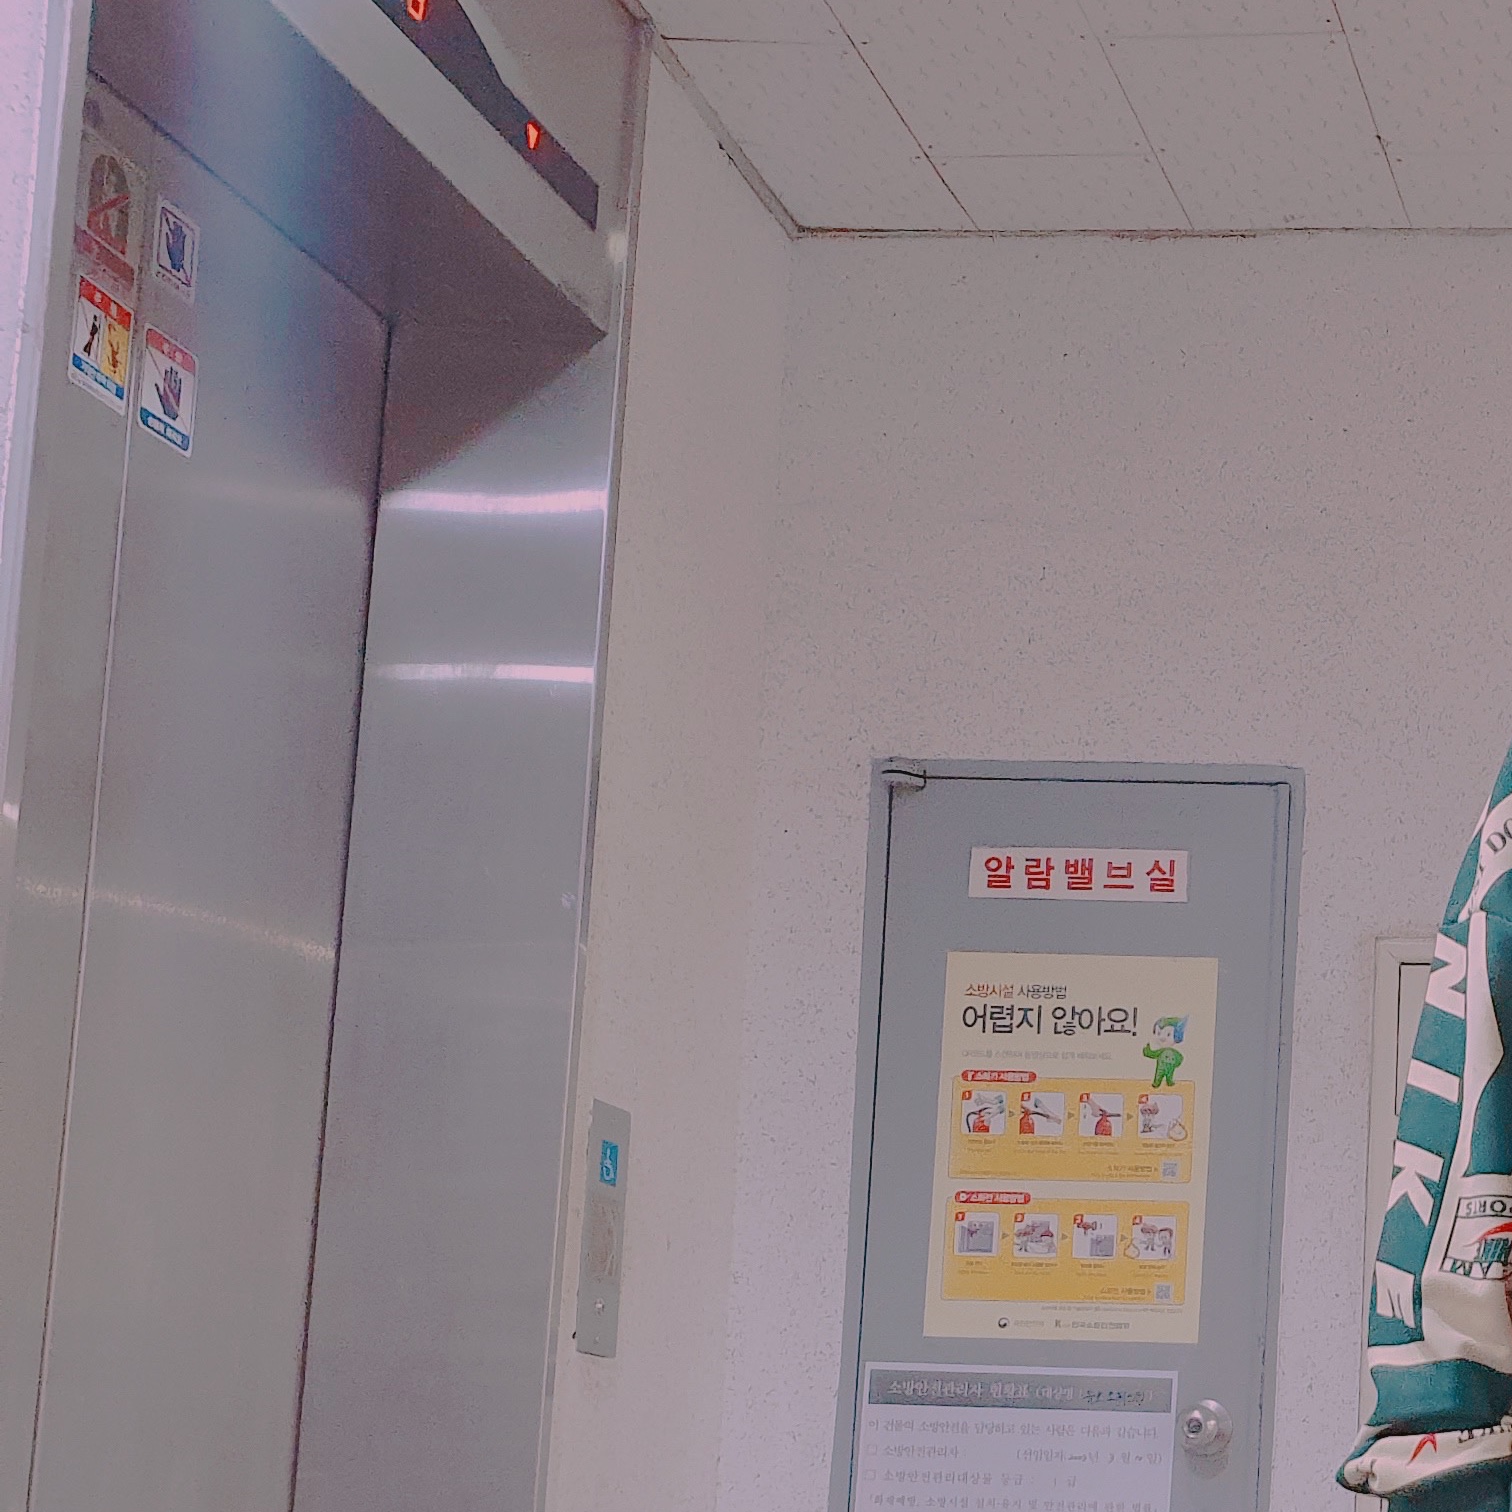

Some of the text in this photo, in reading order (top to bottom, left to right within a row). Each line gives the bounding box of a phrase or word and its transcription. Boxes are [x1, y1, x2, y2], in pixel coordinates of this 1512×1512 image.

[983, 855, 1176, 893] 알람밸브실
[964, 984, 1067, 999] 소방시설 사용방법
[962, 1003, 1138, 1037] 어렵지 않아요!
[1375, 930, 1469, 1330] NIKE
